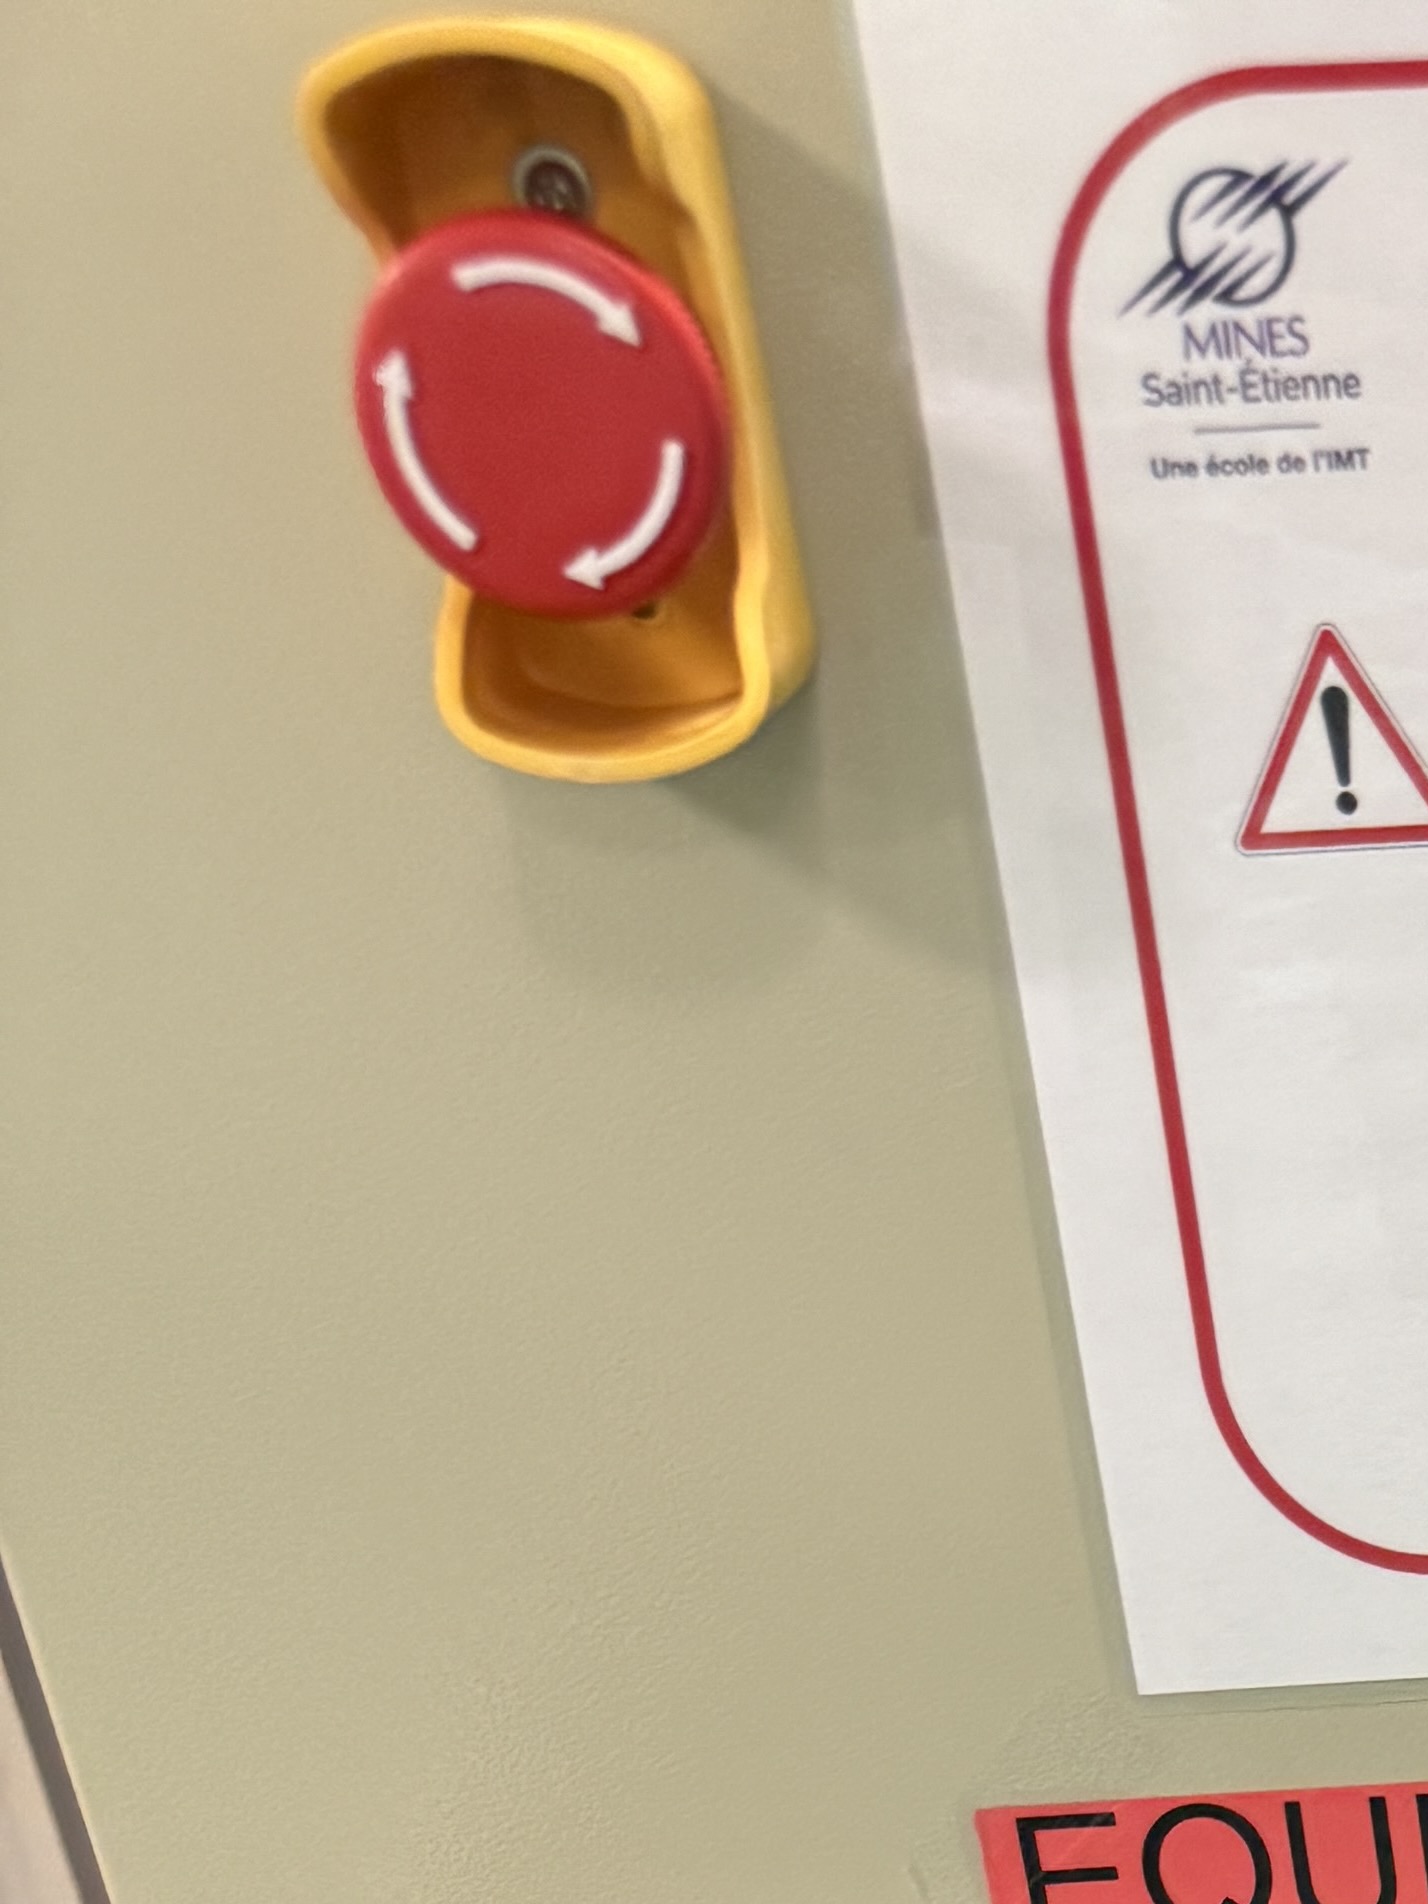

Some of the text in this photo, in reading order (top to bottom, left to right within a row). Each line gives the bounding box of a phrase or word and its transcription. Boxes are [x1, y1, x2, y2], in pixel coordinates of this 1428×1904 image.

[1183, 316, 1312, 361] MINES
[1141, 357, 1363, 408] Saint-Étienne
[1150, 457, 1199, 480] Une
[1204, 452, 1271, 478] école
[1276, 451, 1308, 475] de
